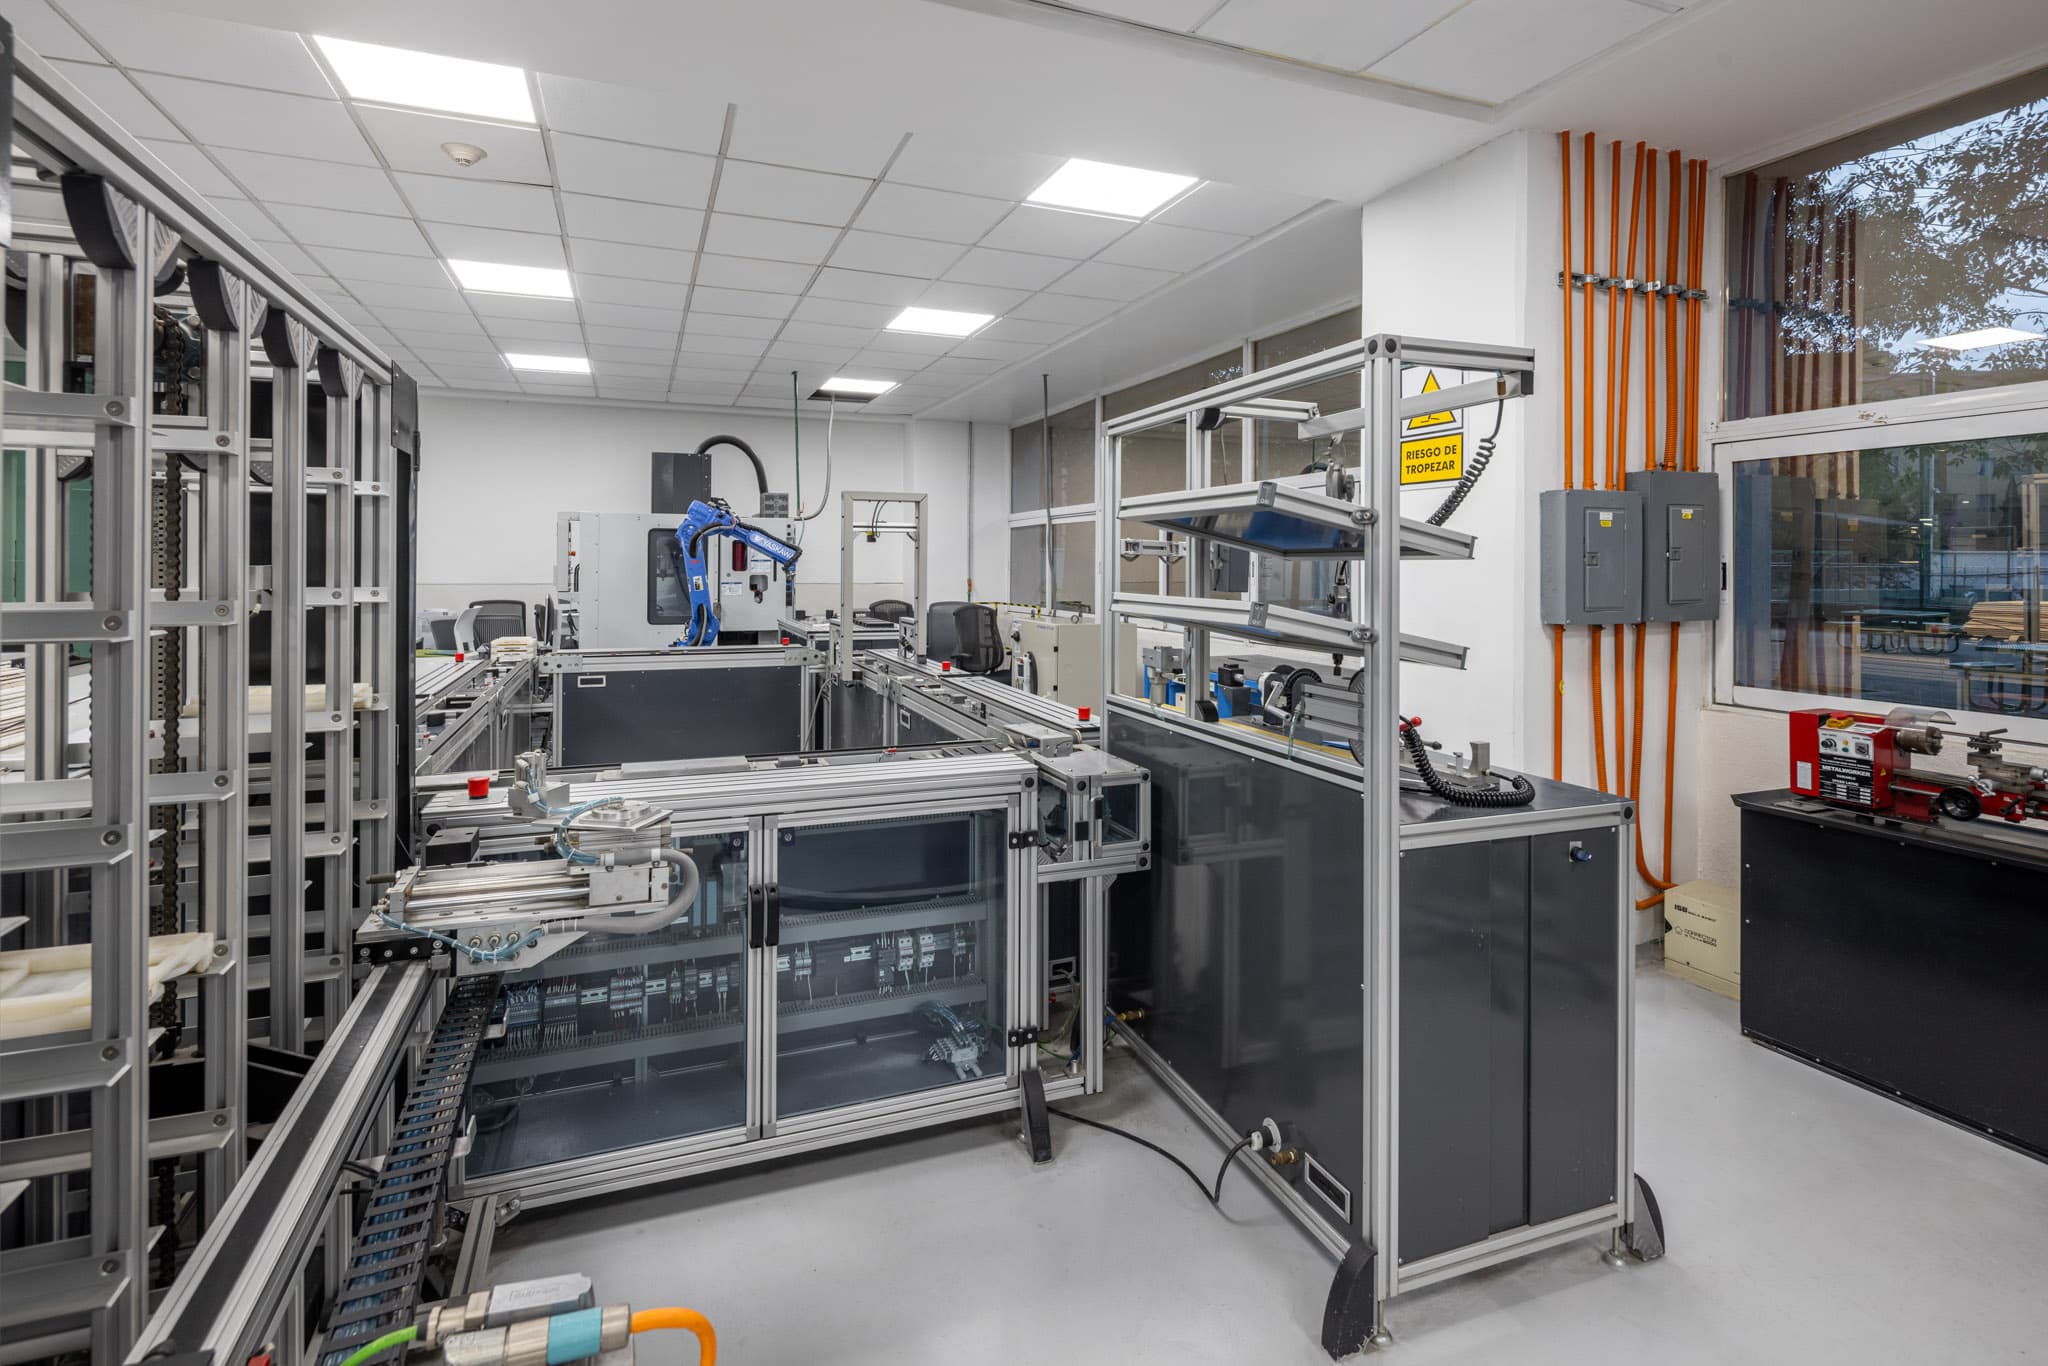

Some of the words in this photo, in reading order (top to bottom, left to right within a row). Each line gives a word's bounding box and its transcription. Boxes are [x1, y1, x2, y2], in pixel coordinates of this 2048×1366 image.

[1406, 447, 1441, 460] RIESGO
[1444, 444, 1457, 456] DE
[1406, 460, 1455, 474] TROPEZAR
